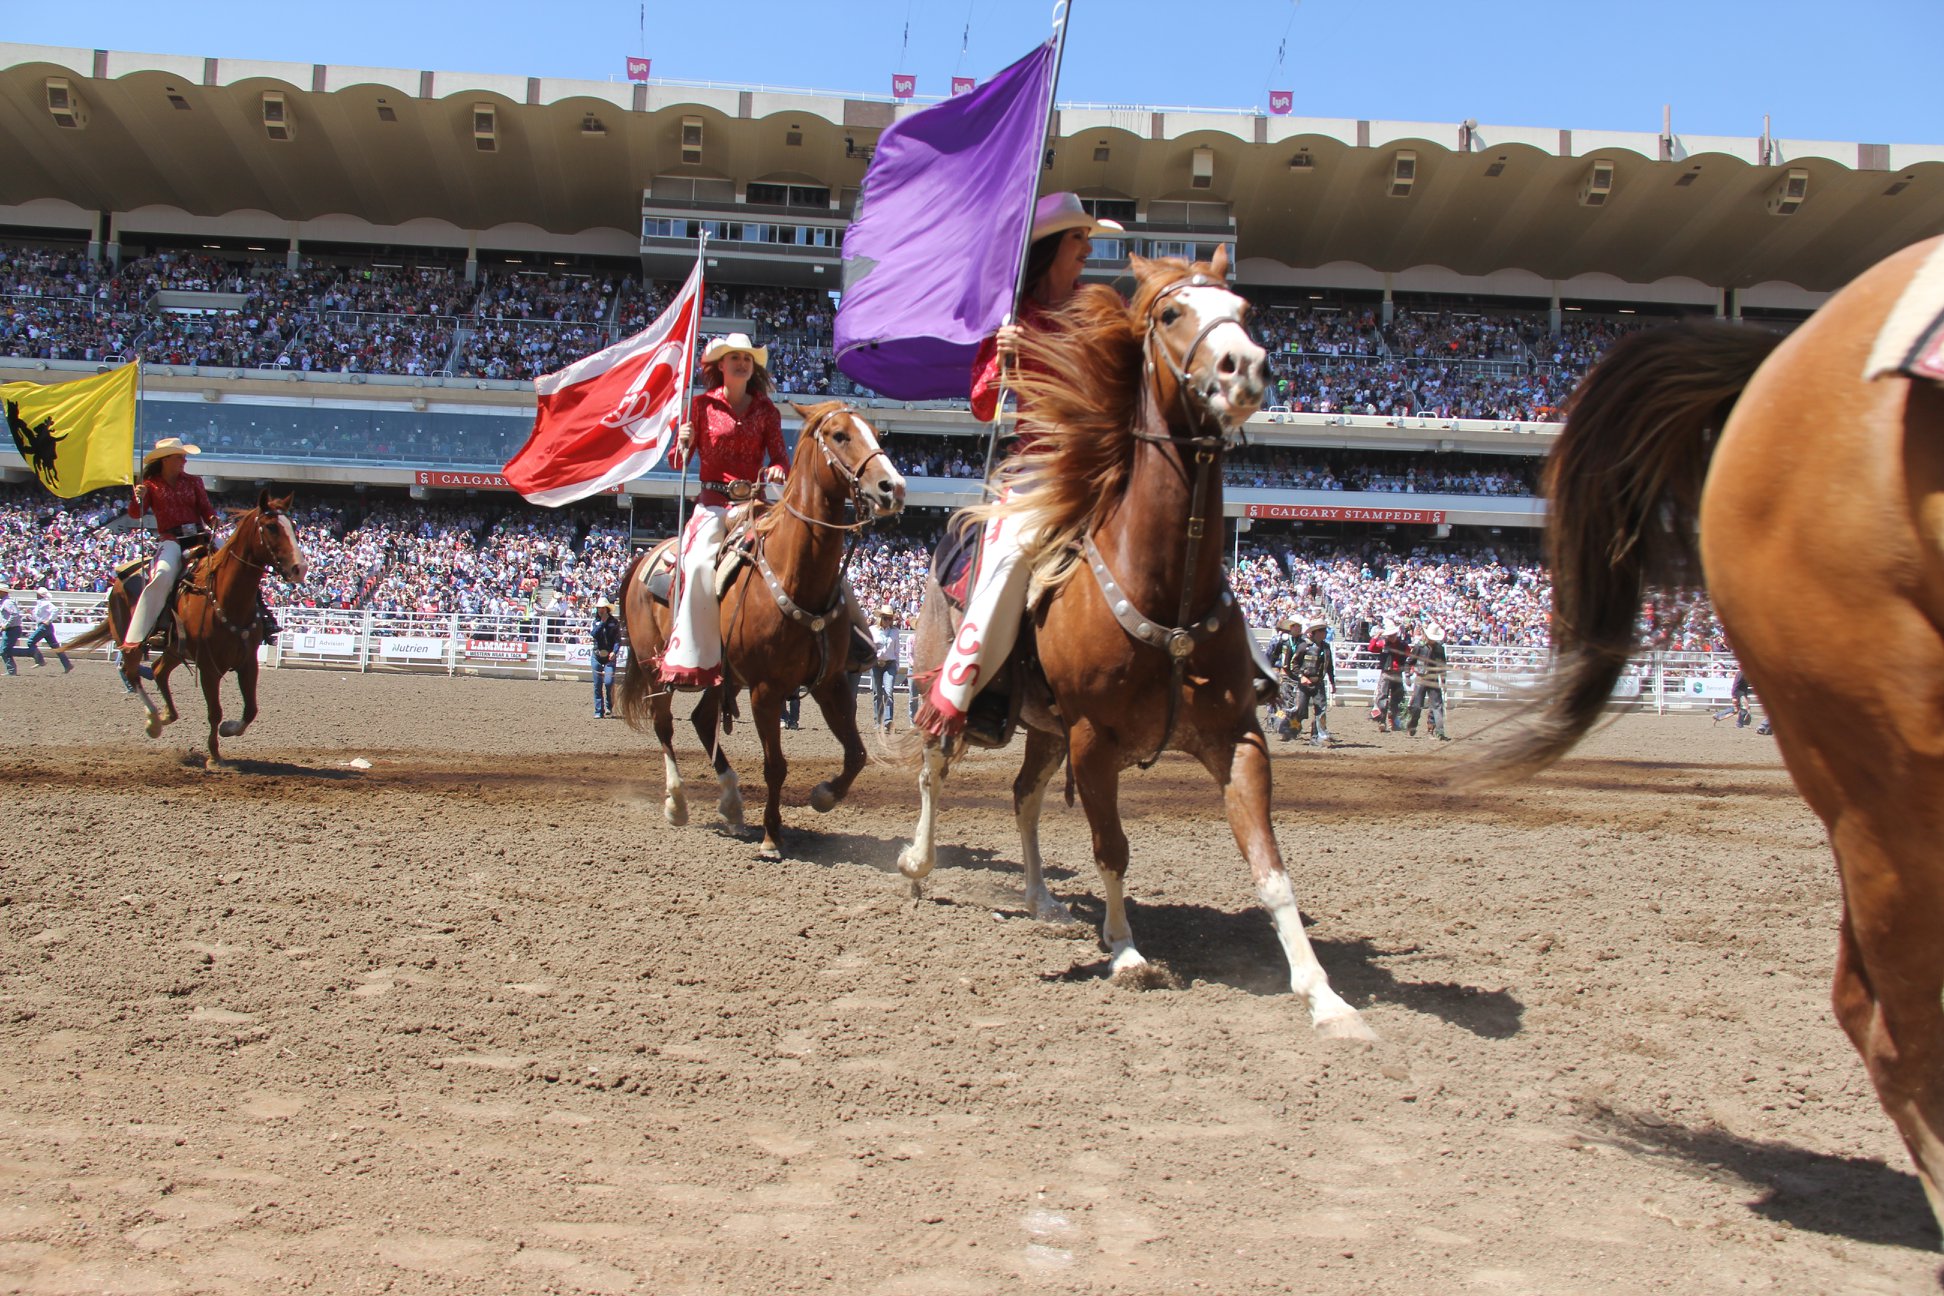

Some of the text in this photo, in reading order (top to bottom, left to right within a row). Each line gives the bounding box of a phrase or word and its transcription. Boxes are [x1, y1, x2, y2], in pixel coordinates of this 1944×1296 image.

[1270, 507, 1340, 518] CALGARY
[1344, 509, 1422, 521] STAMPEDE
[391, 643, 429, 653] Nutrien
[470, 640, 523, 652] LAMMLE'S
